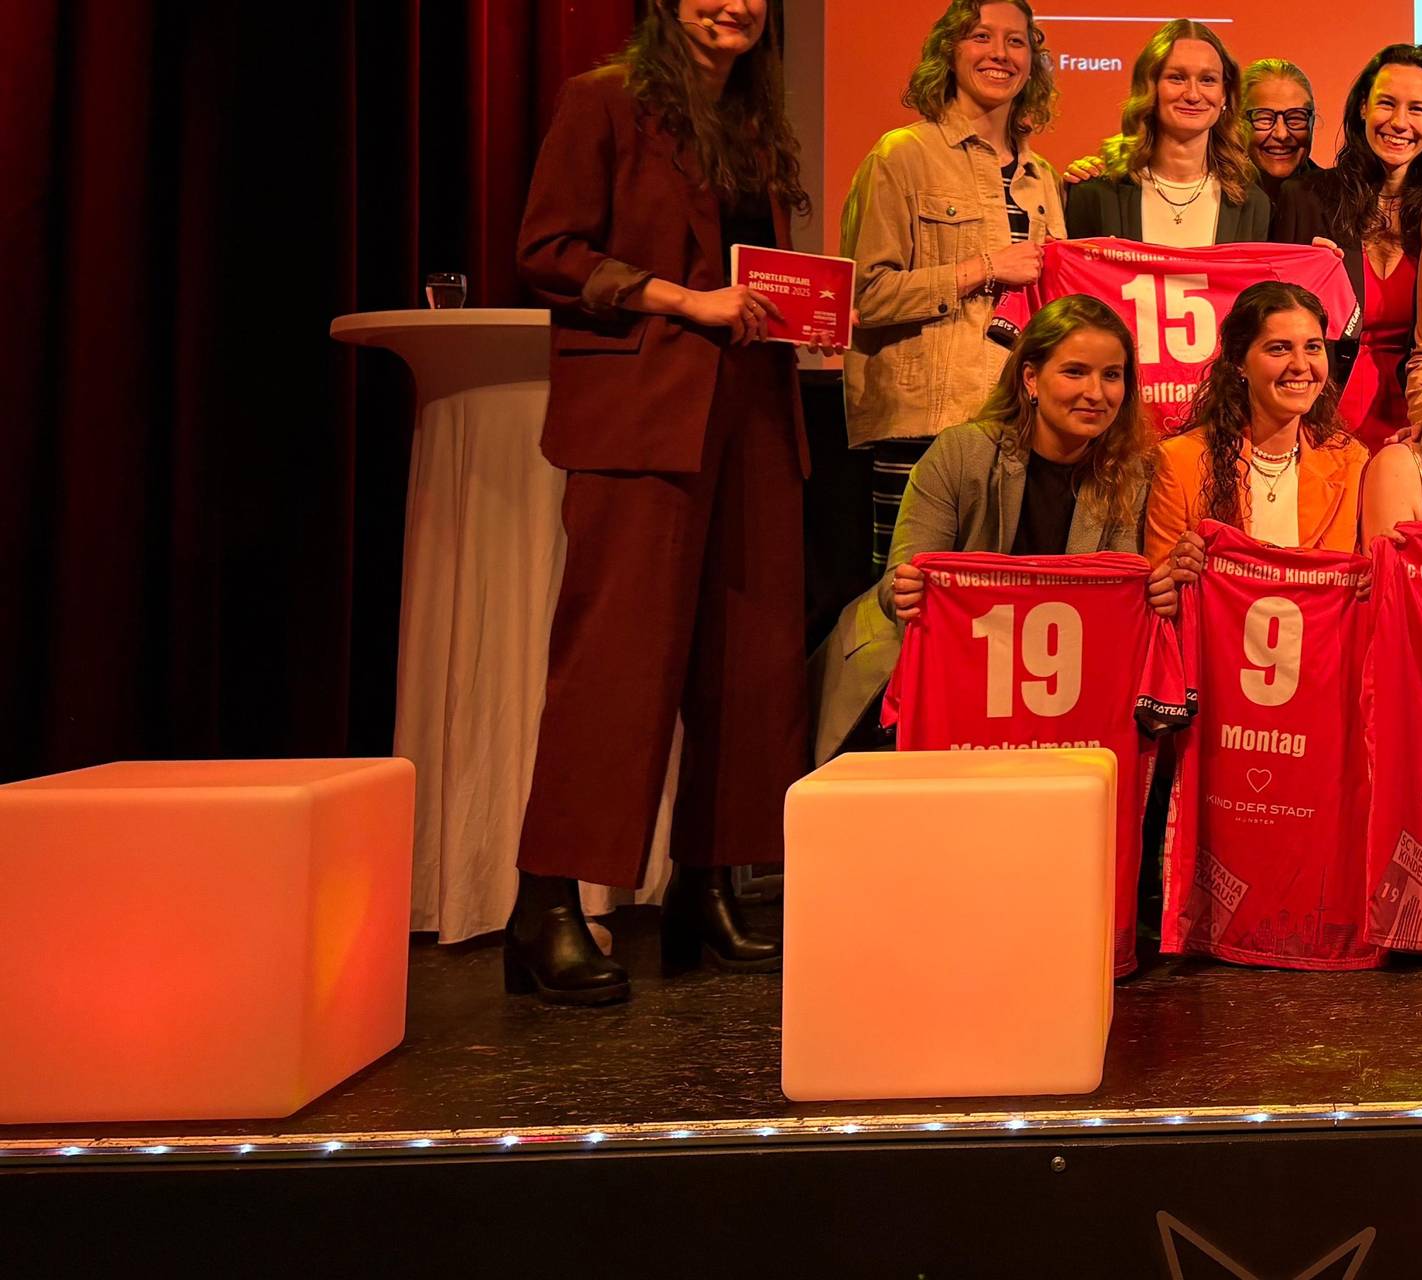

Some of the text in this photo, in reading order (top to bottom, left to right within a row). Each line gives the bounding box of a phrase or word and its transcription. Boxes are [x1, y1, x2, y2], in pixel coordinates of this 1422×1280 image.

[1059, 54, 1122, 71] Frauen
[748, 270, 811, 287] SPORTLERWAHL
[748, 281, 811, 297] MÜNSTER 2025
[1121, 273, 1217, 364] 15
[1213, 557, 1281, 582] Westfalia
[972, 601, 1083, 718] 19
[1240, 596, 1304, 706] 9
[1221, 724, 1306, 757] Montag
[1206, 794, 1315, 818] KIND DER STADT
[1400, 834, 1412, 849] SC
[1381, 882, 1399, 902] 19
